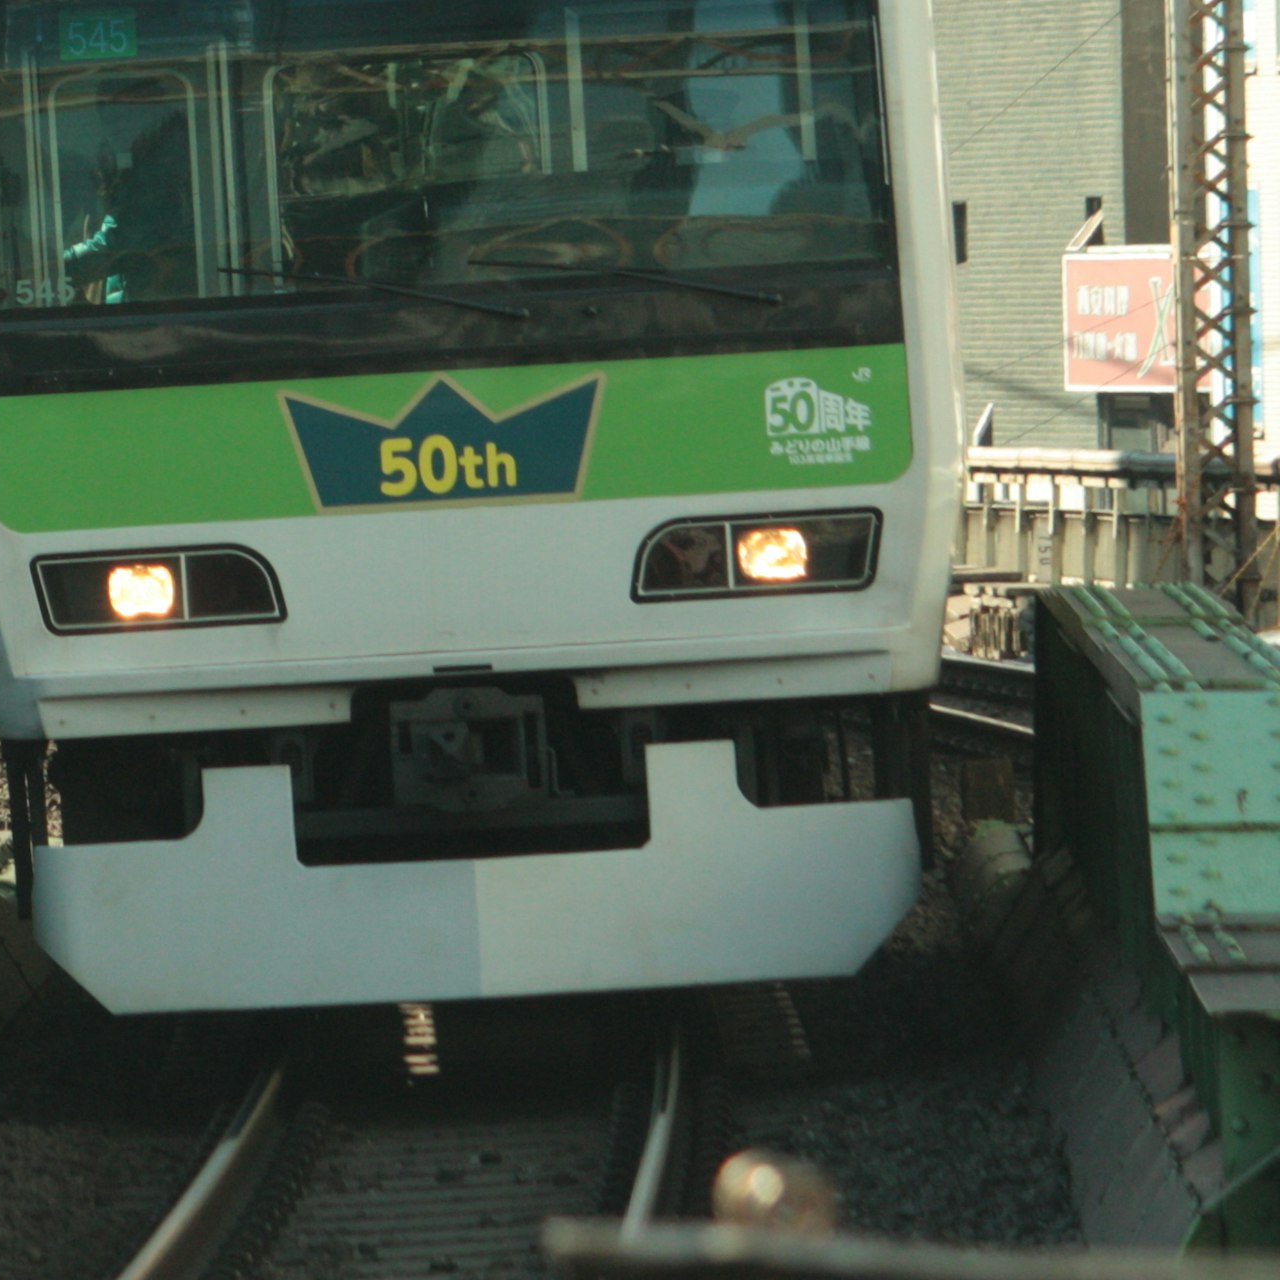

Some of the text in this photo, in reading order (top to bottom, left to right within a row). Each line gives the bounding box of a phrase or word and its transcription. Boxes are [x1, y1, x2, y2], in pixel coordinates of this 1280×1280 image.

[68, 20, 128, 56] 545
[15, 276, 76, 307] 545
[851, 367, 872, 382] JR
[379, 435, 517, 497] 50th
